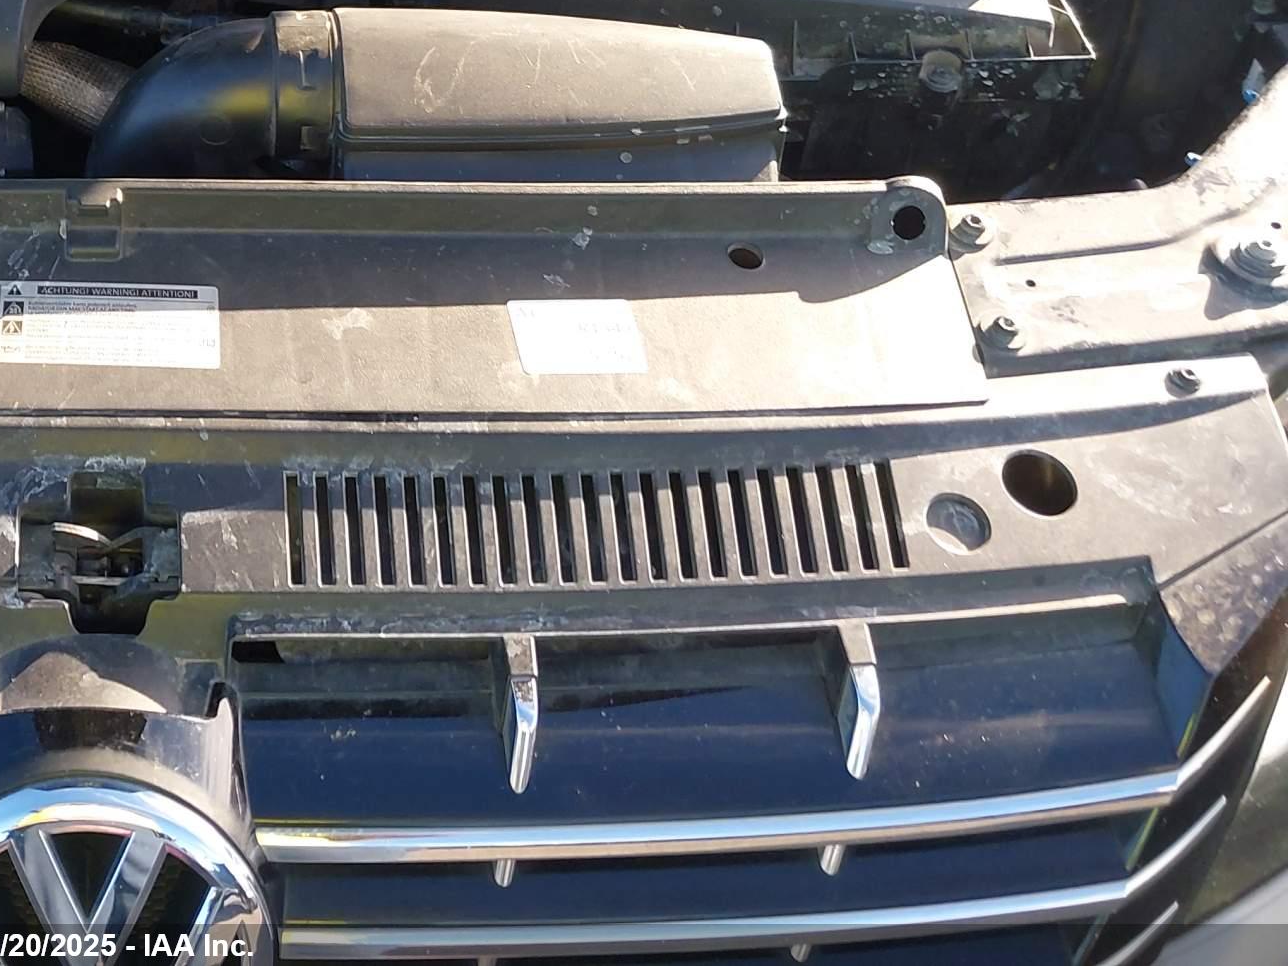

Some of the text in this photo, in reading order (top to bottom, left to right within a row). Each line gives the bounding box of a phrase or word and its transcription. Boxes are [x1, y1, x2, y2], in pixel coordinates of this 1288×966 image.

[40, 286, 195, 299] ACHTUNG! WARNING! ATTENTION!
